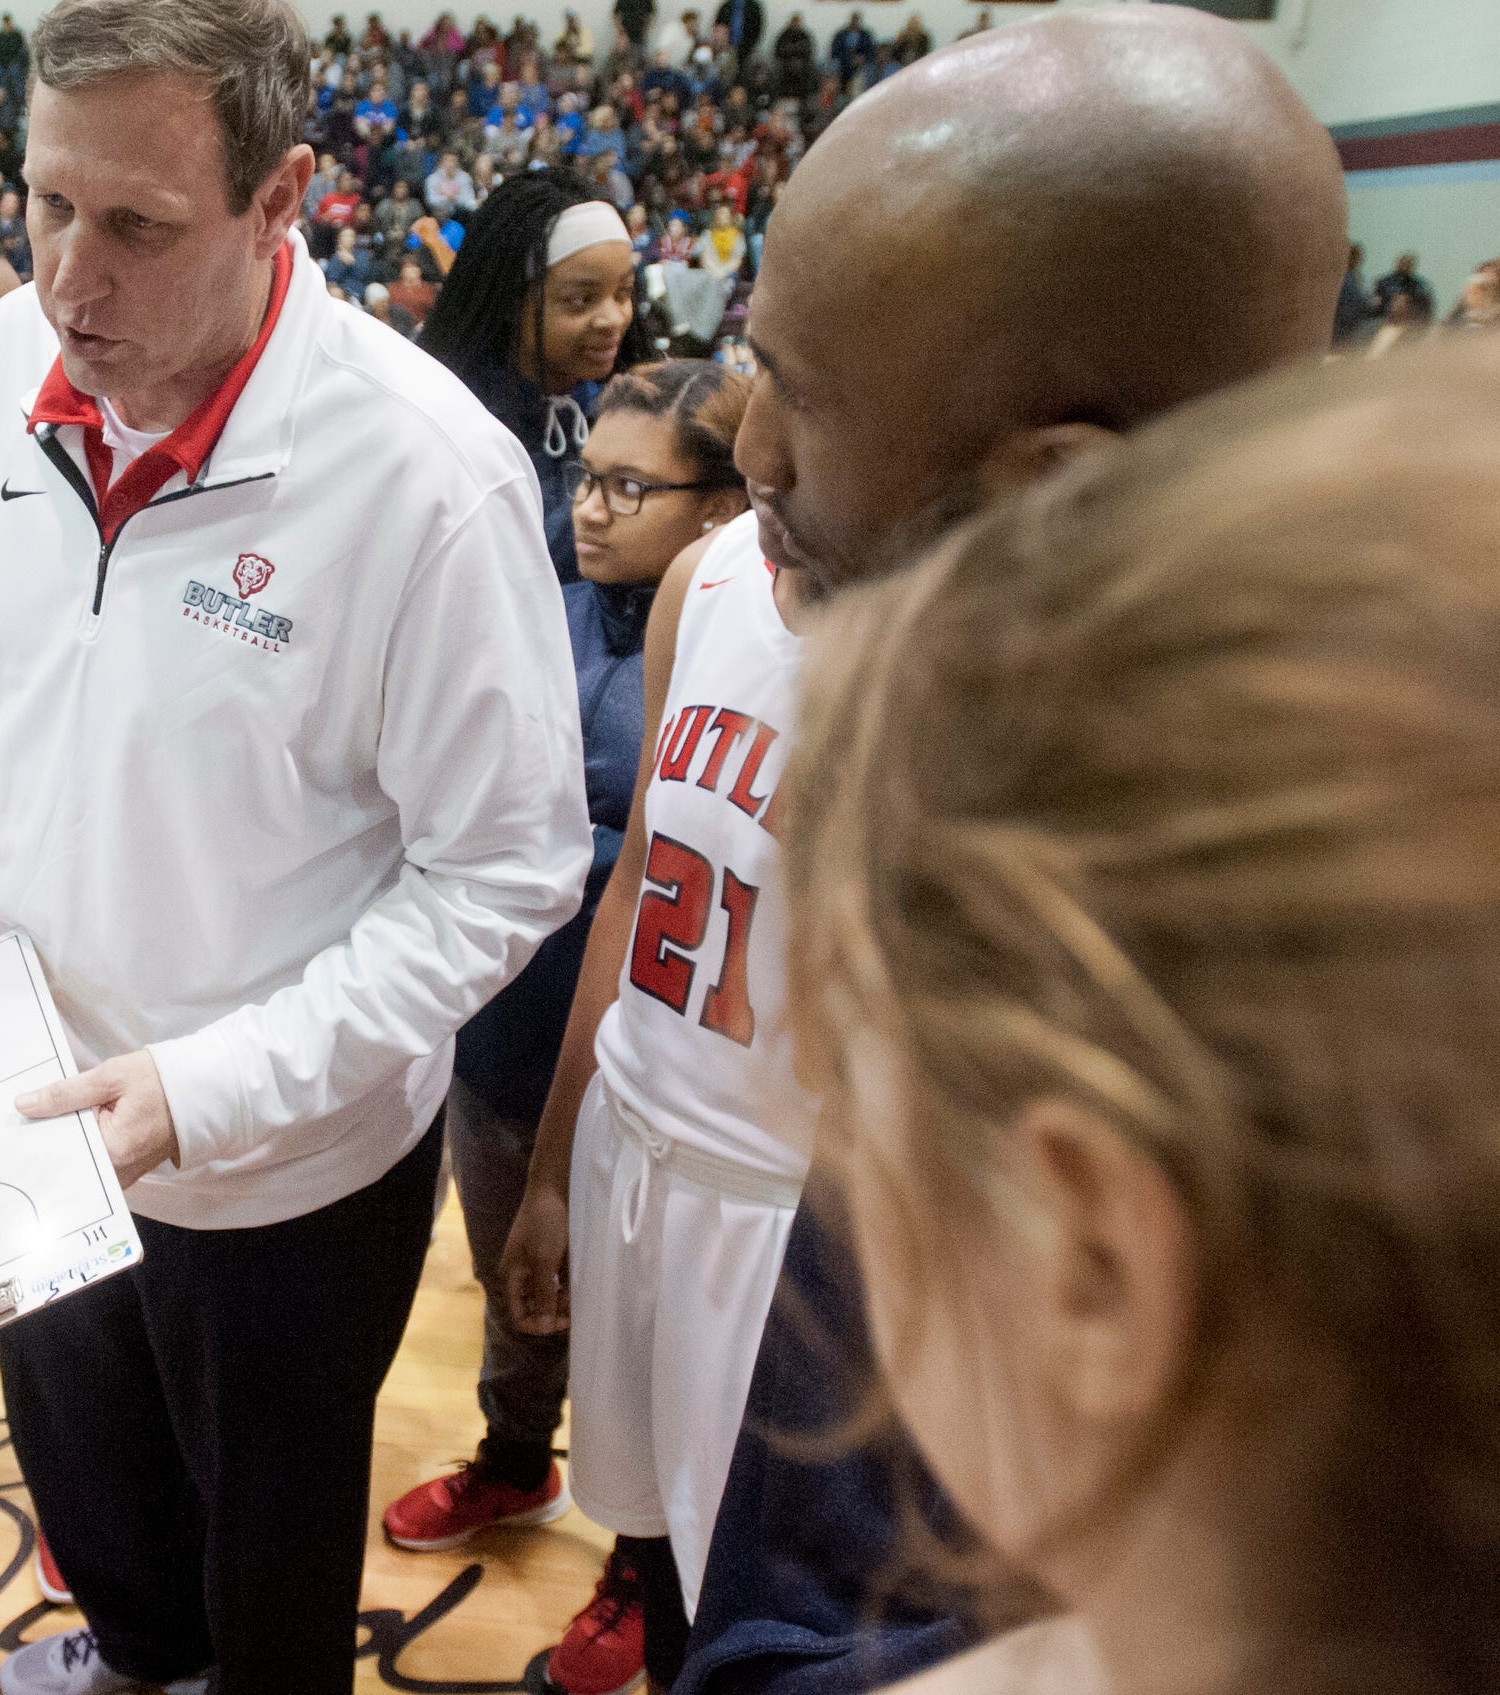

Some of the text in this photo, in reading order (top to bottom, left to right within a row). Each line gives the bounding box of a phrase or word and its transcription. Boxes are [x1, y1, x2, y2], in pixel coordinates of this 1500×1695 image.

[183, 580, 293, 643] BUTLER
[183, 608, 280, 653] BASKETBALL
[630, 830, 760, 1049] 21
